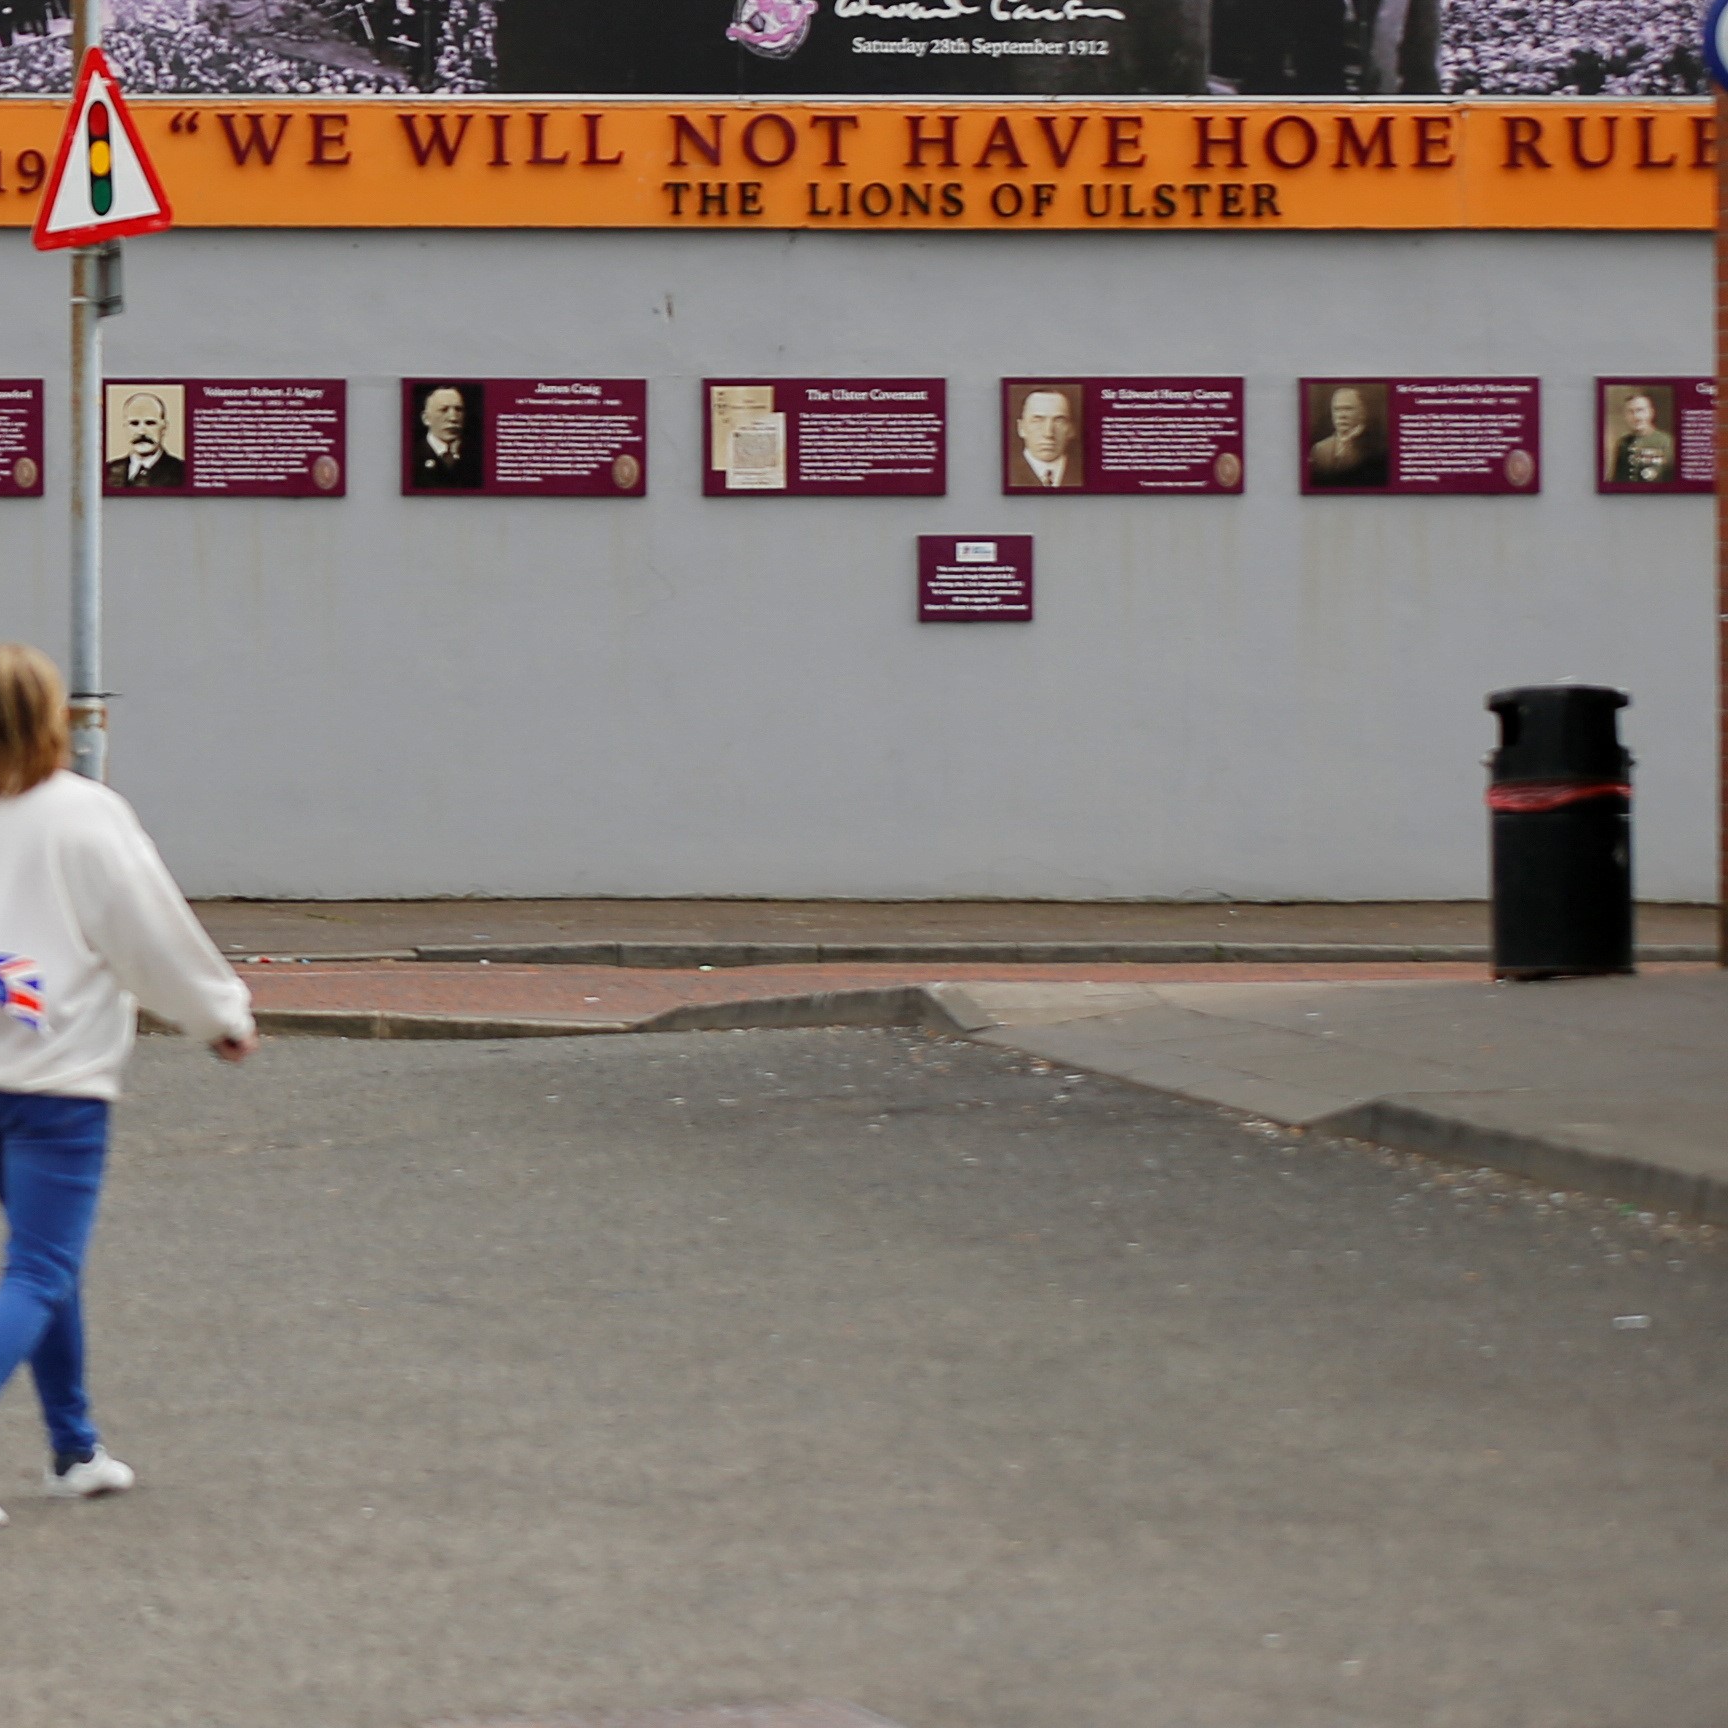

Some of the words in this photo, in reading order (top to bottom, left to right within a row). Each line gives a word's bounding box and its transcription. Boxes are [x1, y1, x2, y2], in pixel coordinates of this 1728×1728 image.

[851, 36, 929, 57] Saturday
[929, 37, 971, 54] 28th
[971, 37, 1066, 58] September
[1067, 40, 1110, 56] 1912
[169, 110, 353, 167] “WE
[398, 113, 625, 167] WILL
[667, 113, 859, 168] NOT
[903, 115, 1149, 169] HAVE
[1191, 115, 1456, 169] HOME
[1500, 116, 1718, 170] RULE
[662, 181, 764, 218] THE
[805, 182, 965, 218] LIONS
[990, 183, 1057, 218] OF
[1081, 183, 1283, 219] ULSTER
[805, 389, 830, 400] The
[831, 389, 868, 400] Ulster
[869, 389, 929, 400] Covenant
